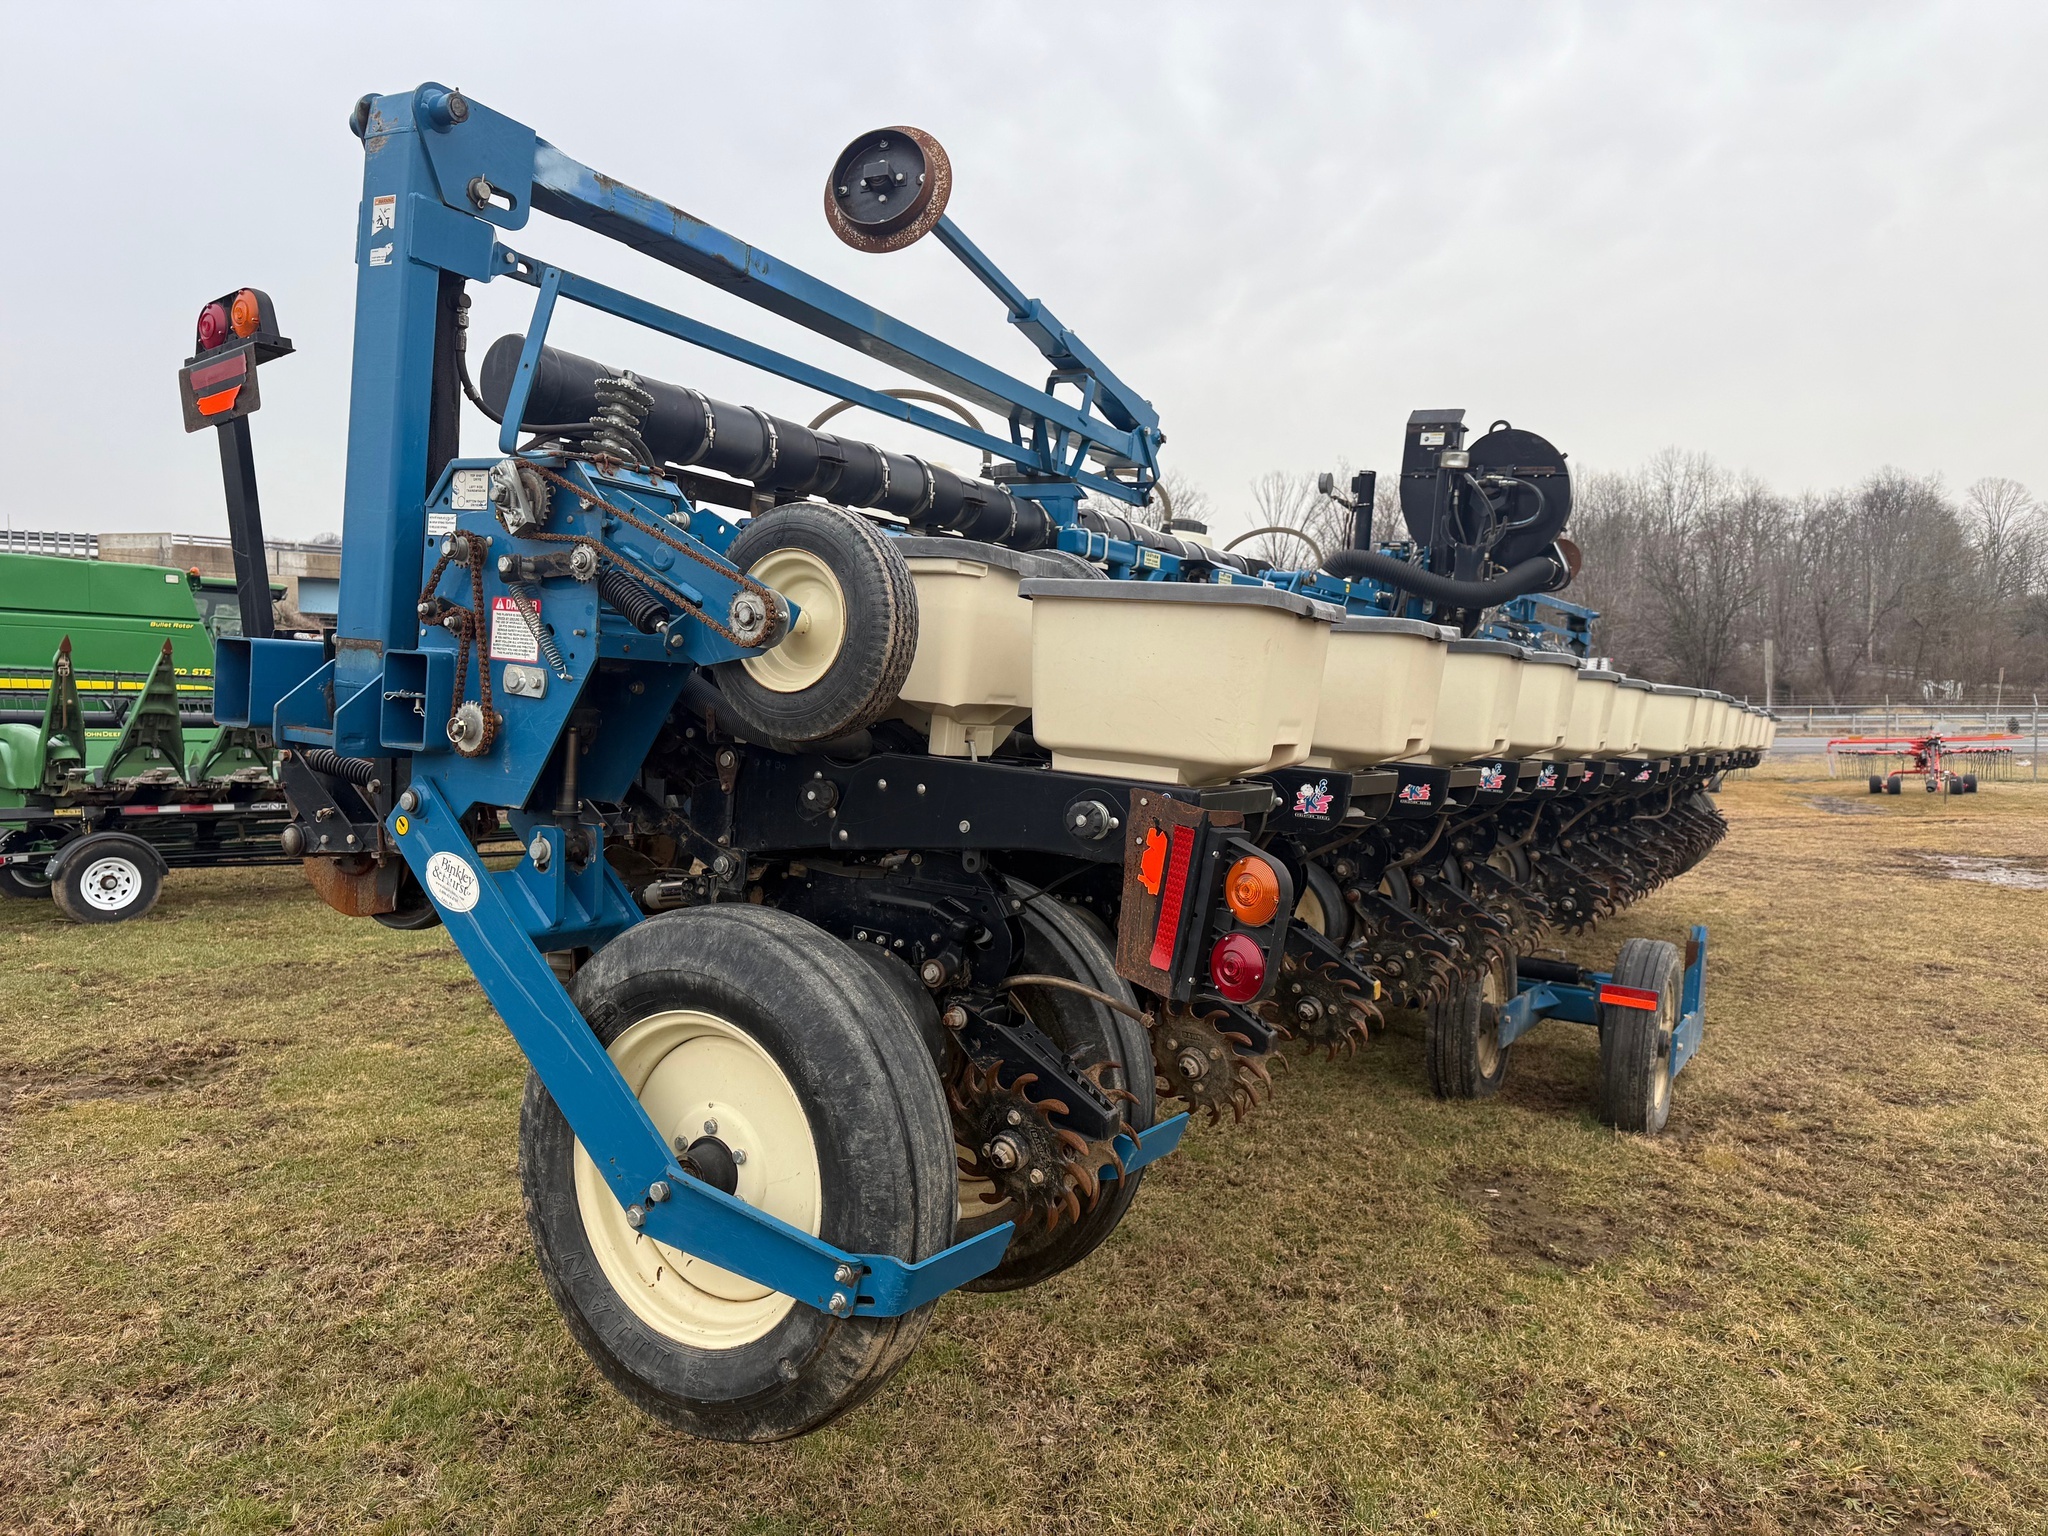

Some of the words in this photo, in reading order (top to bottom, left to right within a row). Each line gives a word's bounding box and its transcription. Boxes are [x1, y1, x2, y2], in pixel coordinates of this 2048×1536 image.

[191, 668, 212, 676] STS
[432, 865, 442, 881] &
[441, 872, 468, 896] Hurst
[441, 857, 474, 889] Binkley
[561, 1250, 671, 1371] TITAN
